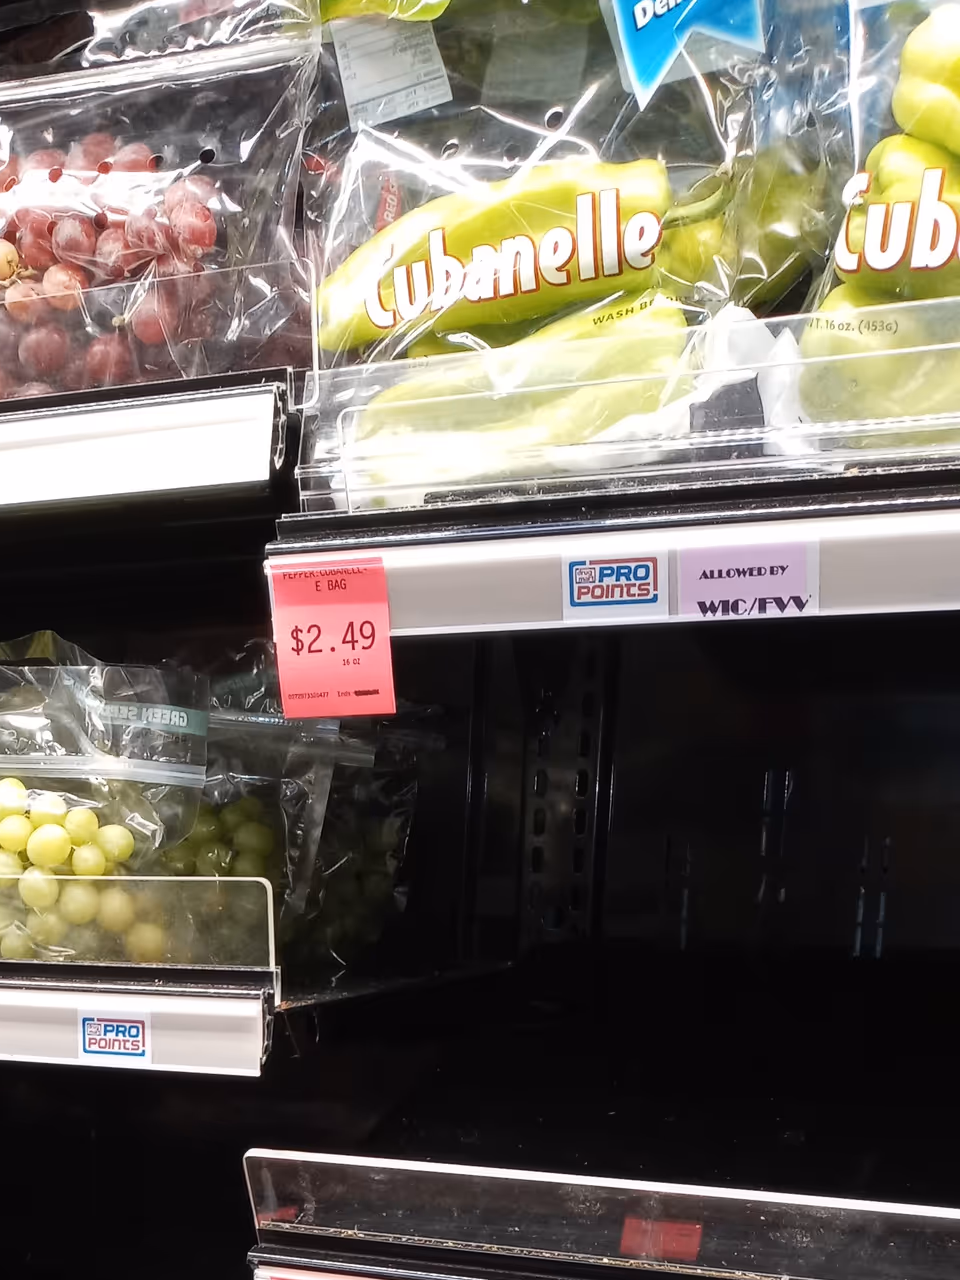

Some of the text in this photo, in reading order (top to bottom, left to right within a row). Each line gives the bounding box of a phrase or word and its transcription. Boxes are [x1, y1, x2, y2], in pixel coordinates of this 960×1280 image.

[835, 167, 960, 274] Cub
[364, 187, 665, 329] Cubanelle
[592, 307, 634, 326] WASH
[825, 319, 836, 330] 16
[598, 564, 650, 583] PRO
[699, 565, 789, 580] ALLOWED BY
[315, 579, 347, 591] E BAG
[576, 583, 651, 600] POINTS
[697, 596, 812, 617] WIC/FVV
[290, 620, 376, 656] $2.49
[103, 1024, 140, 1038] PRO
